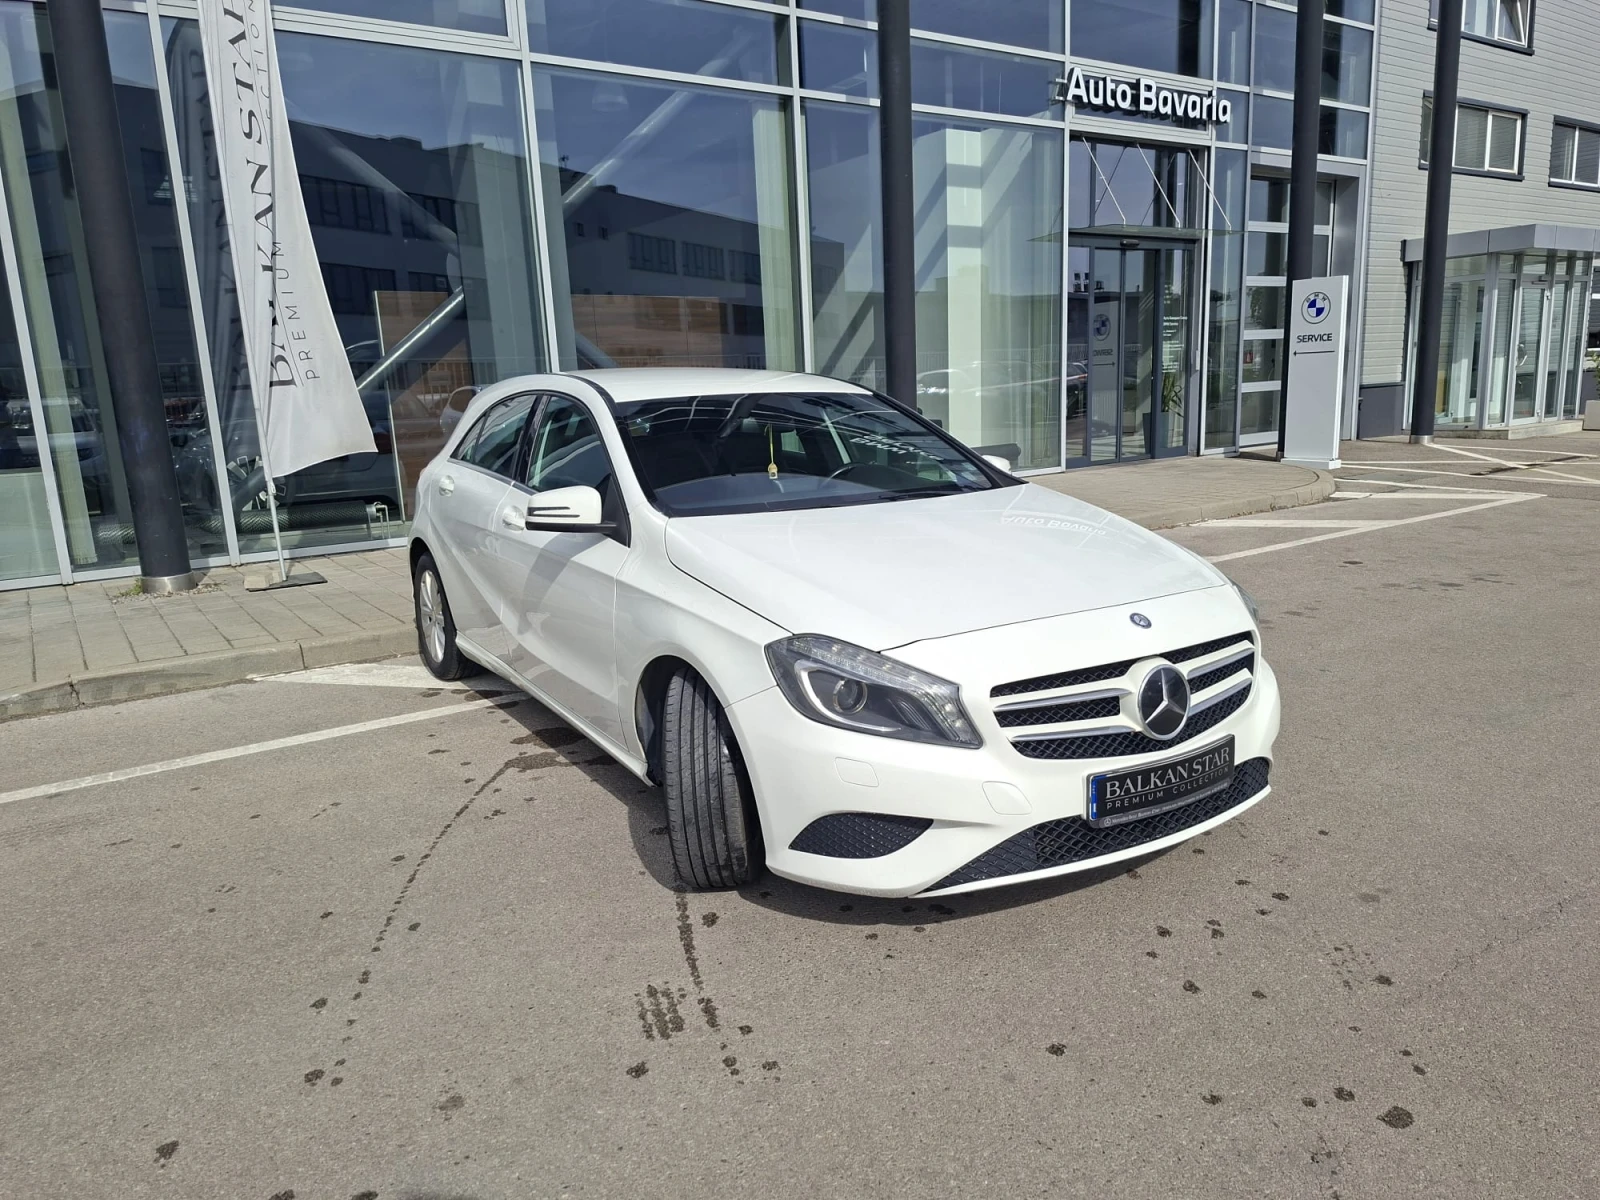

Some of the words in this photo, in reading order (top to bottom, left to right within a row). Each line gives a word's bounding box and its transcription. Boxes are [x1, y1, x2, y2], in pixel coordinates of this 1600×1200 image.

[1066, 66, 1132, 110] Auto
[1138, 77, 1232, 123] Bavaria
[273, 241, 321, 380] PREMIUM
[1296, 333, 1333, 343] SERVICE
[1105, 762, 1189, 799] BALKAN
[1191, 746, 1230, 777] STAR
[1106, 790, 1165, 810] PREMIUM
[1172, 766, 1229, 794] COLLECTION
